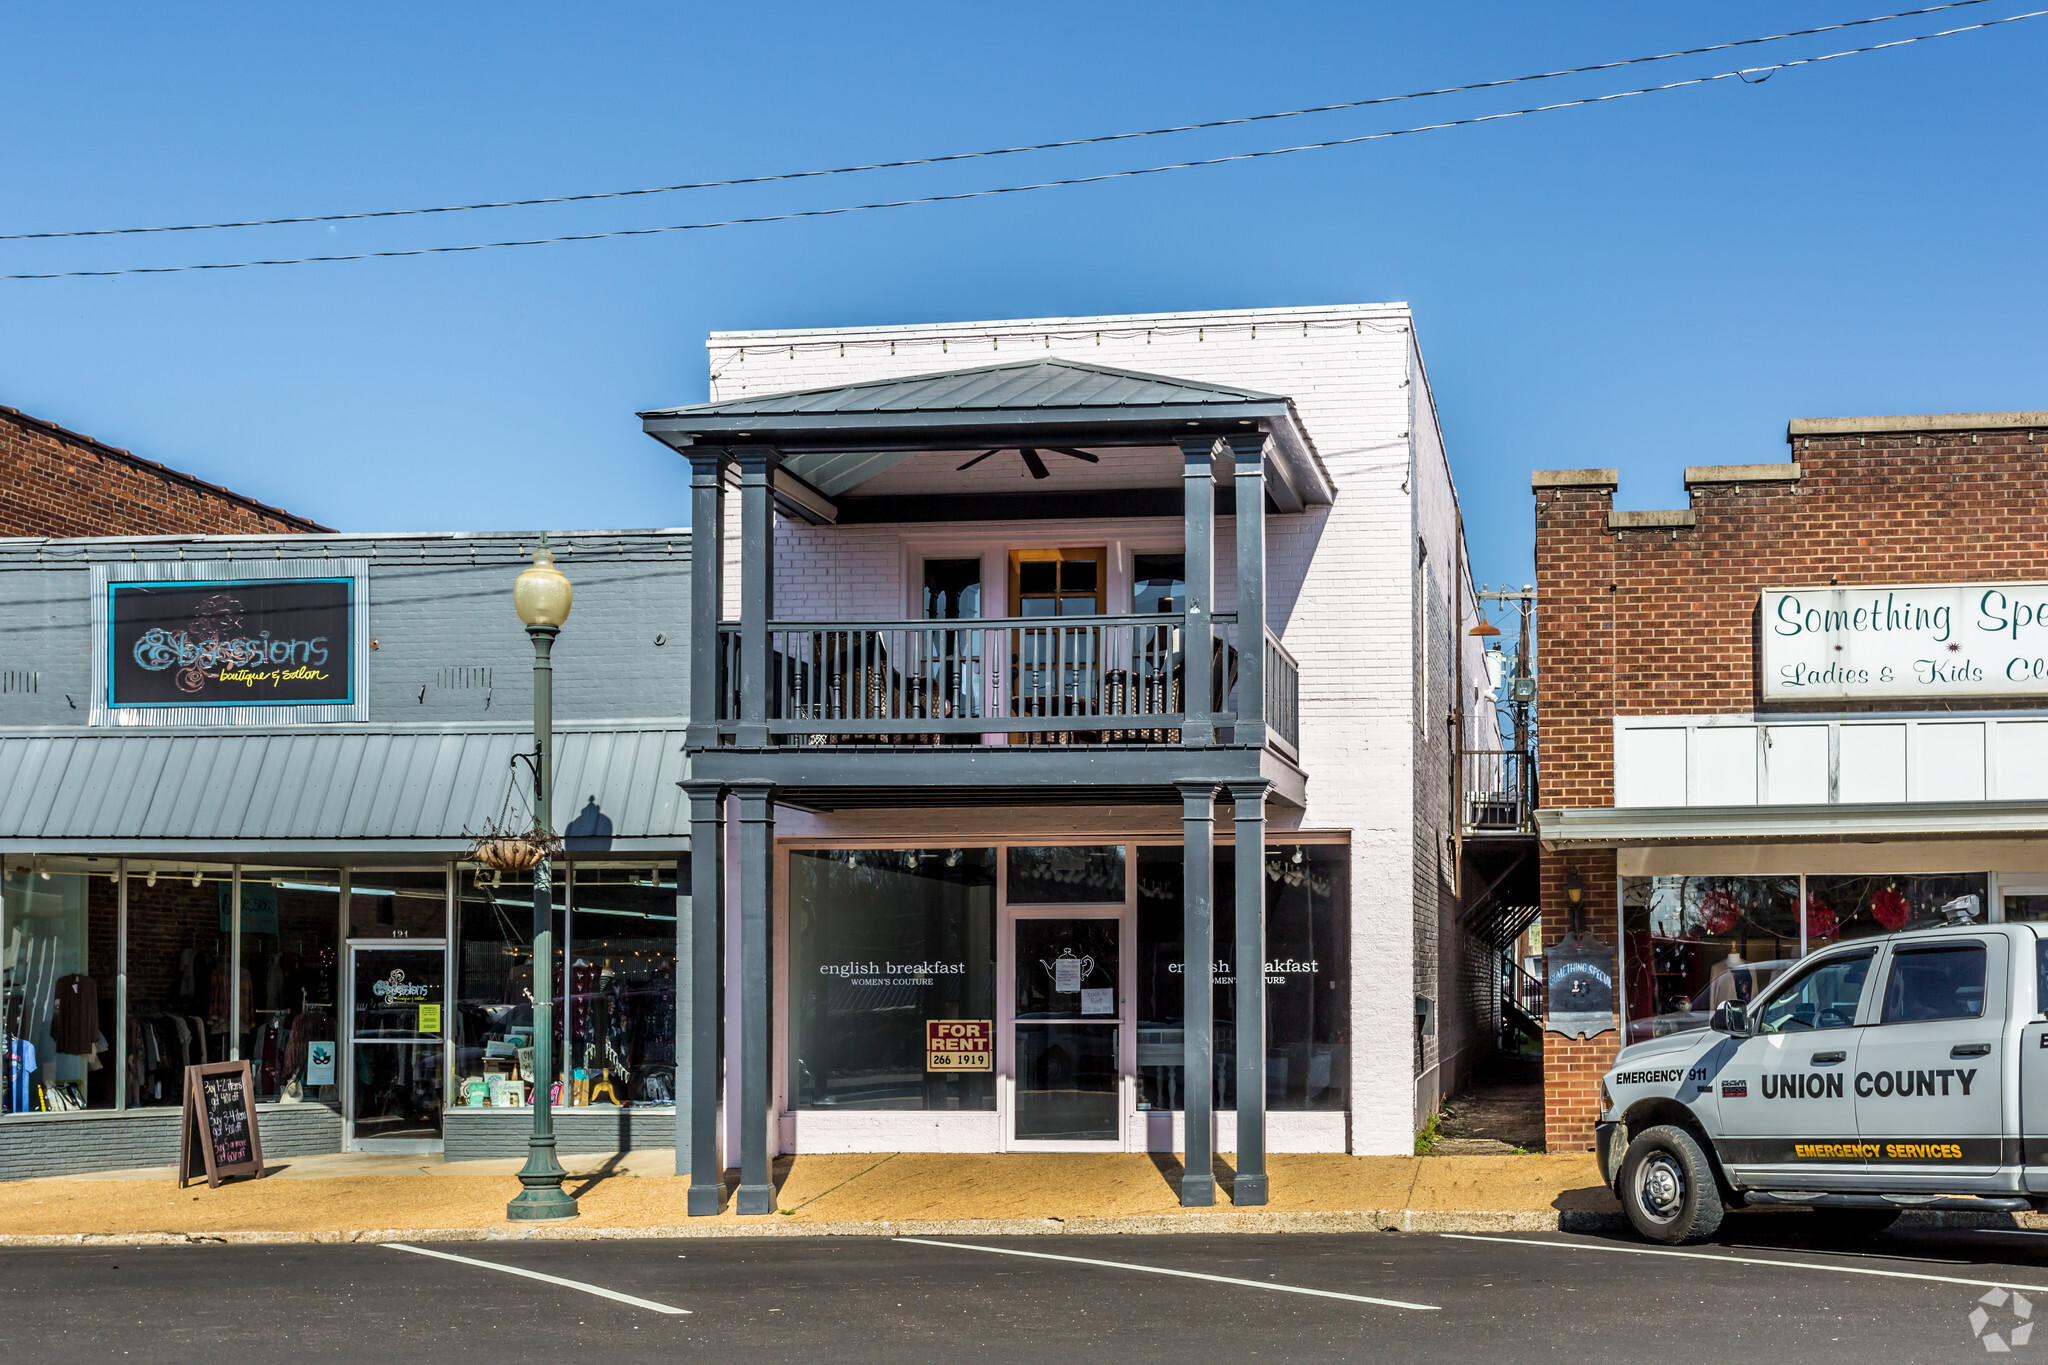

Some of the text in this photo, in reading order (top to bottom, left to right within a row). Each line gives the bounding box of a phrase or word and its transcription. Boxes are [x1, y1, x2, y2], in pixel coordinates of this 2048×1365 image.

[1774, 589, 2048, 642] Something Spe
[133, 628, 328, 671] Obsessions
[219, 668, 271, 688] boutique
[283, 665, 329, 680] salon
[1780, 657, 2048, 687] Ladies & Kids Cl
[820, 961, 965, 977] english breakfast
[1168, 958, 1319, 973] ensh akfast
[851, 978, 934, 986] WOMEN'S COUTURE
[1548, 962, 1613, 989] SOMETHING SPECIAL
[938, 1024, 981, 1037] FOR
[931, 1038, 988, 1051] RENT
[933, 1054, 985, 1065] 266 1919
[1616, 1068, 1707, 1084] EMERGENCY 911
[1761, 1069, 1977, 1099] UNION COUNTY
[1795, 1144, 1962, 1158] EMERGENCY SERVICES
